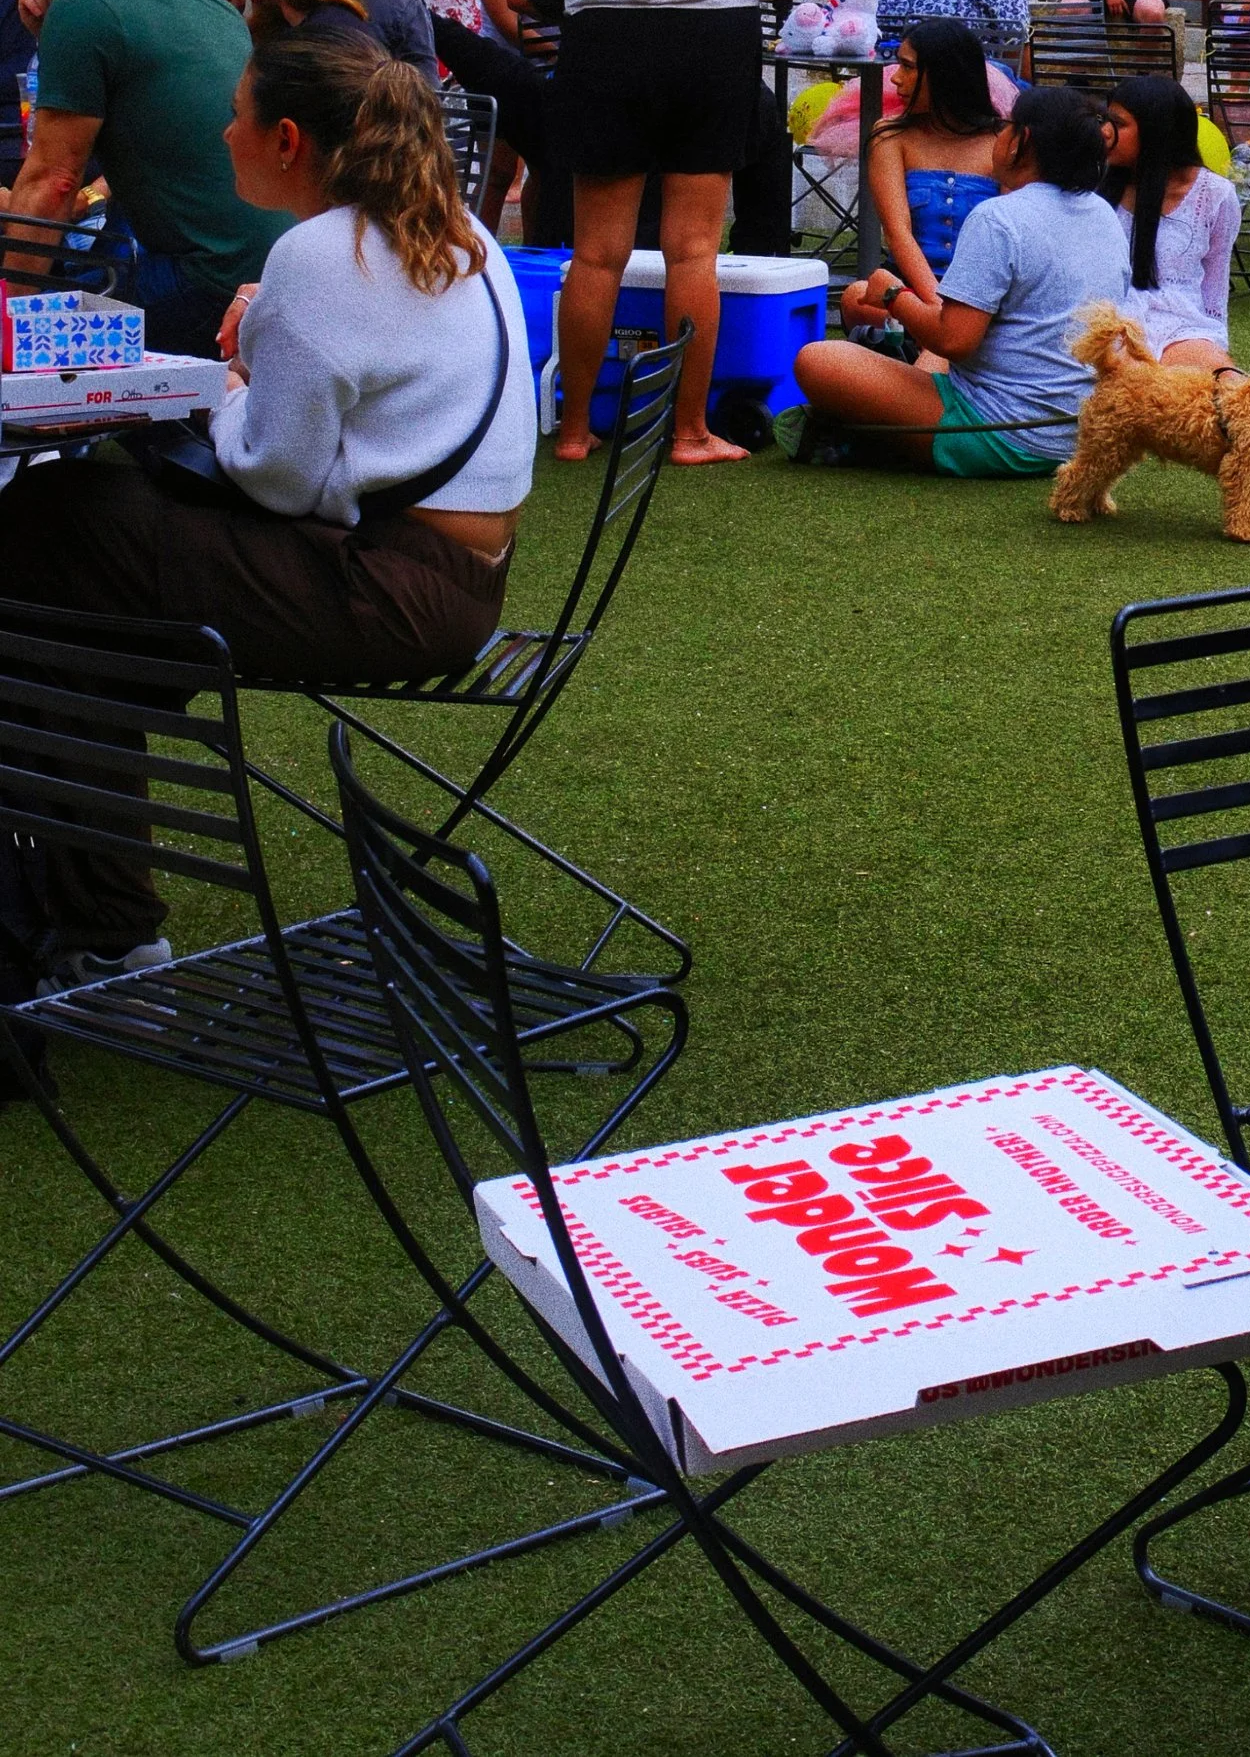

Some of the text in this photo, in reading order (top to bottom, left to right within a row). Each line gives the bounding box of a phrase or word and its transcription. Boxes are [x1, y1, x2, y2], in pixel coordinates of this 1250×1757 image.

[614, 328, 642, 336] IGLOO
[86, 391, 113, 404] FOR
[828, 1134, 991, 1231] Slice
[986, 1132, 1134, 1239] ORDER ANOTHER!
[1030, 1114, 1208, 1234] WONDERSLICEPIZZA.COM
[618, 1195, 798, 1327] PIZZA SUBS SALADS
[720, 1159, 959, 1319] Wonder
